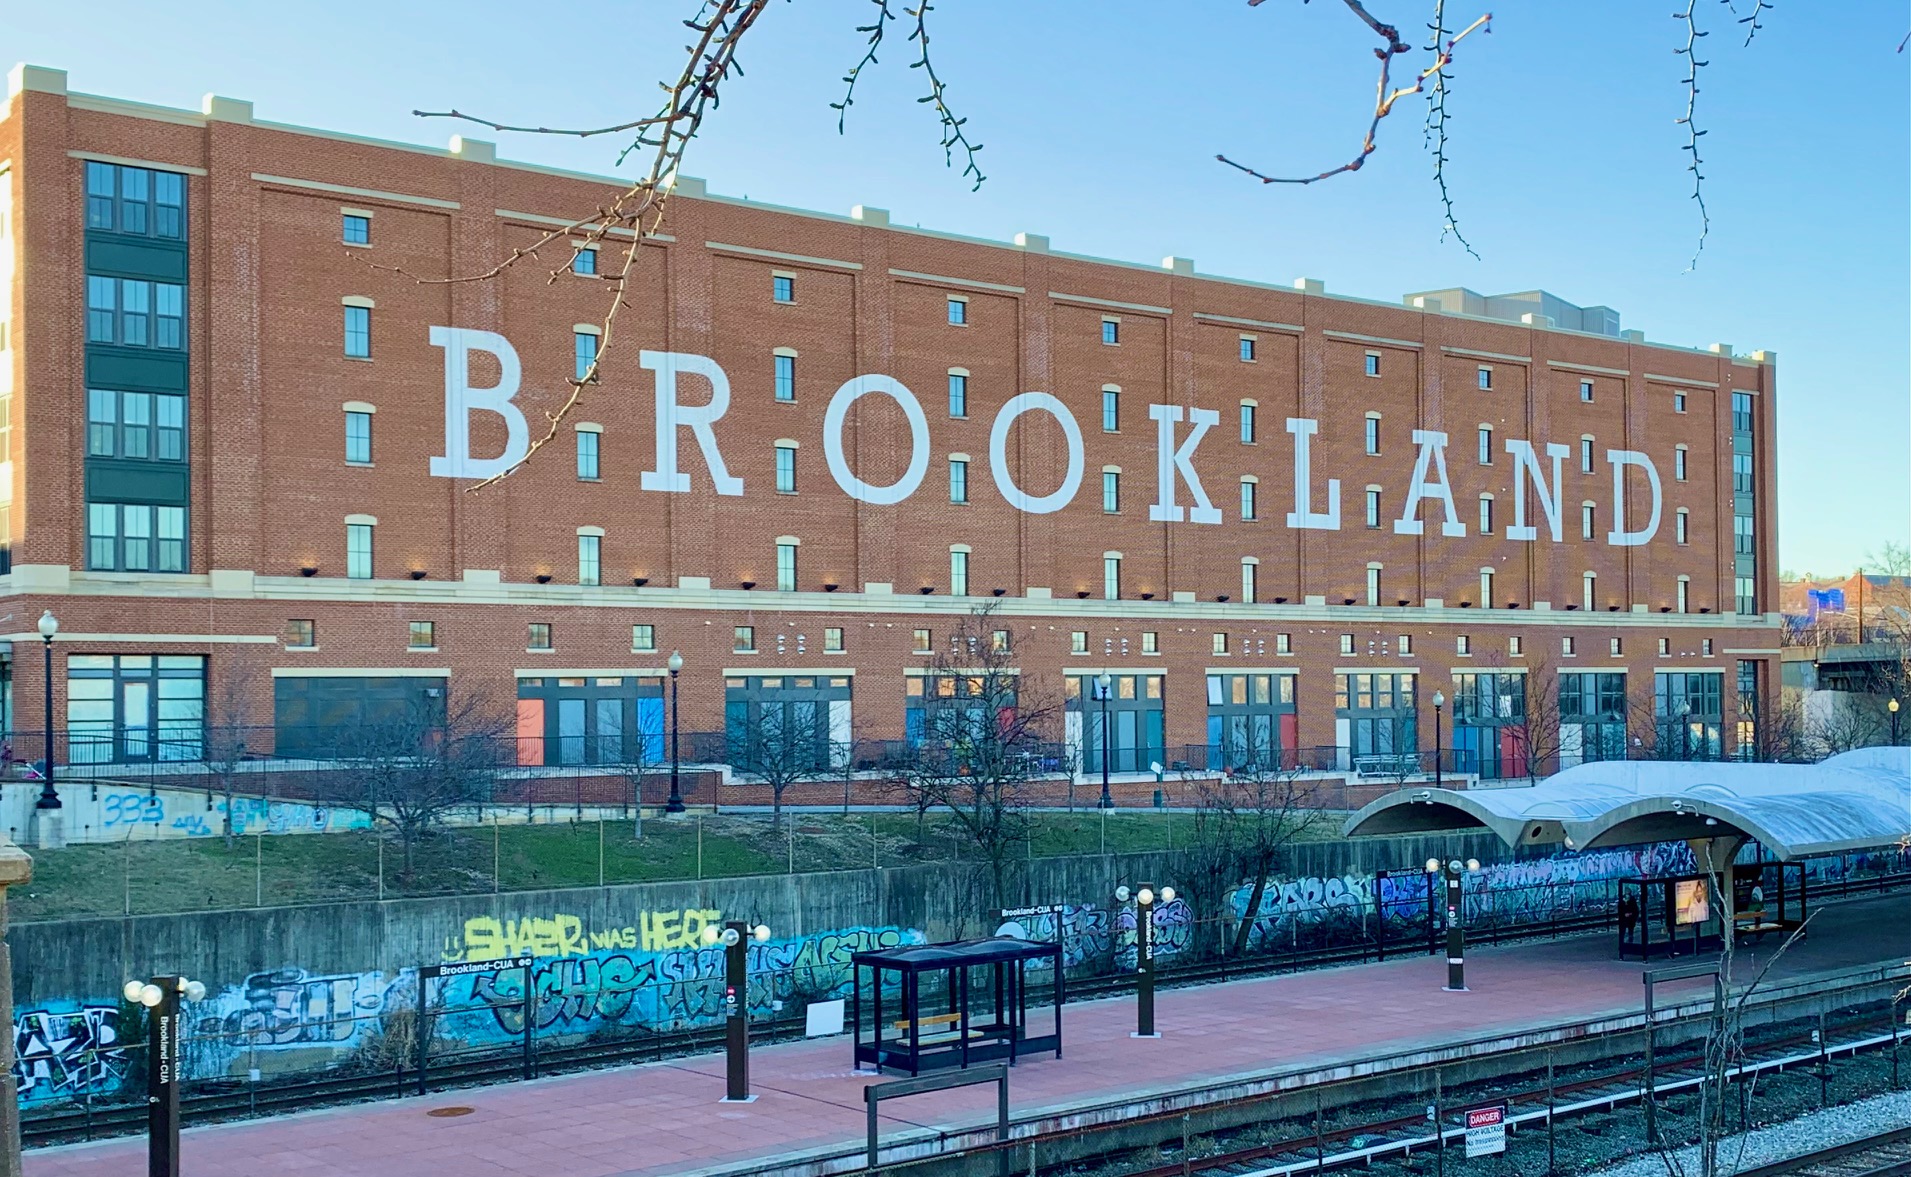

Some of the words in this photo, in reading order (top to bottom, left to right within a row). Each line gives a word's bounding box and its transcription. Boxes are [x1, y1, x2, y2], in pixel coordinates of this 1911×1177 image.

[429, 325, 1662, 546] BROOKLAND
[104, 794, 164, 827] 333
[1002, 906, 1051, 917] Brookland-CUA
[590, 927, 637, 949] WAS
[440, 960, 514, 976] Brookland-CUA
[1470, 1112, 1500, 1124] DANGER
